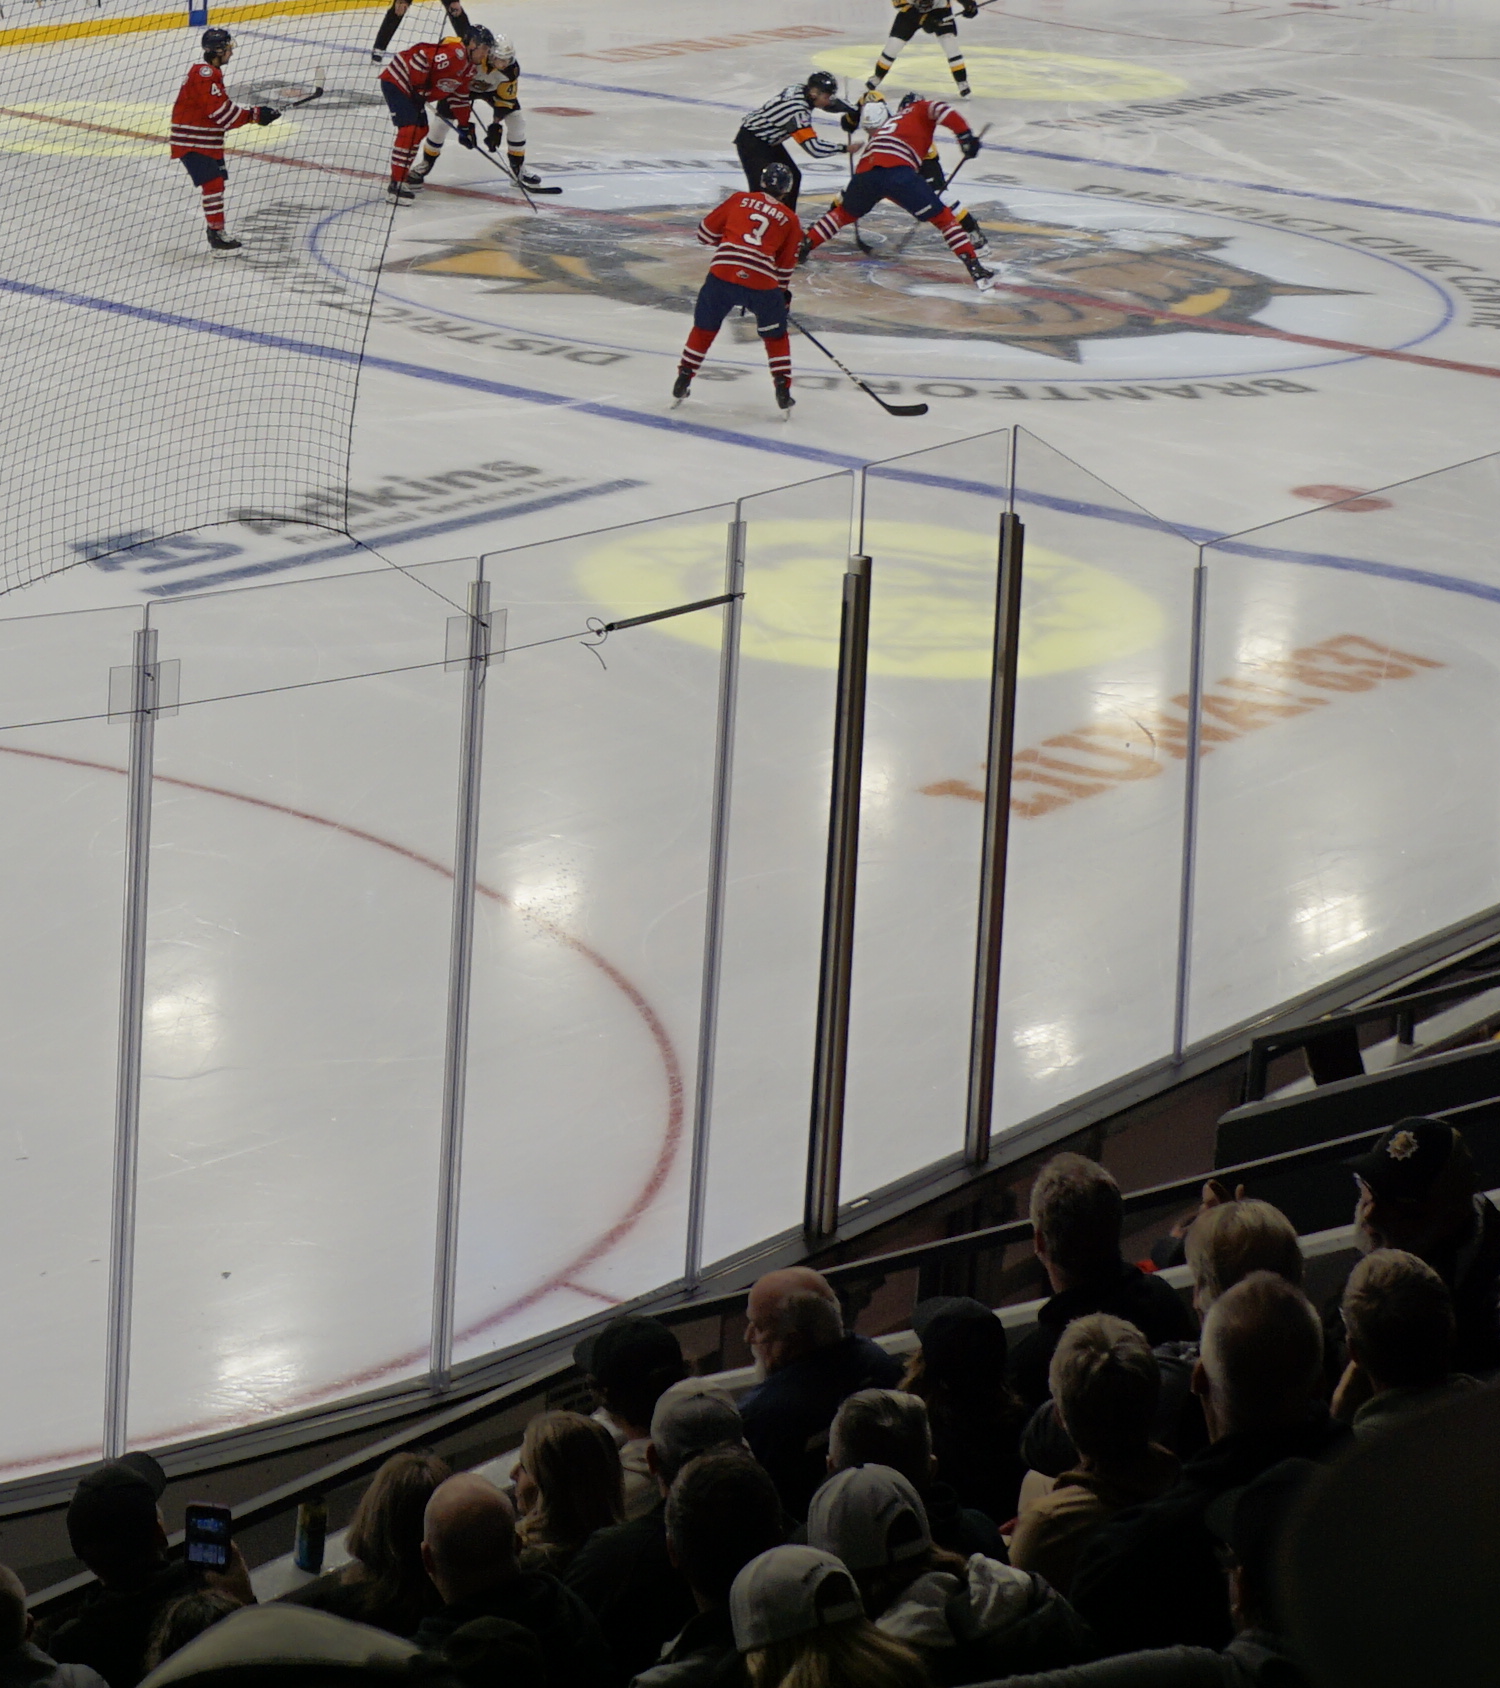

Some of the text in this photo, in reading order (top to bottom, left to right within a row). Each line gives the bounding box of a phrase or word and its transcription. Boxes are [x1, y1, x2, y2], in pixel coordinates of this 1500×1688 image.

[739, 197, 790, 226] STEWART
[1074, 183, 1362, 234] DISTRICT
[1346, 234, 1485, 274] CIVIC
[742, 213, 765, 247] 3
